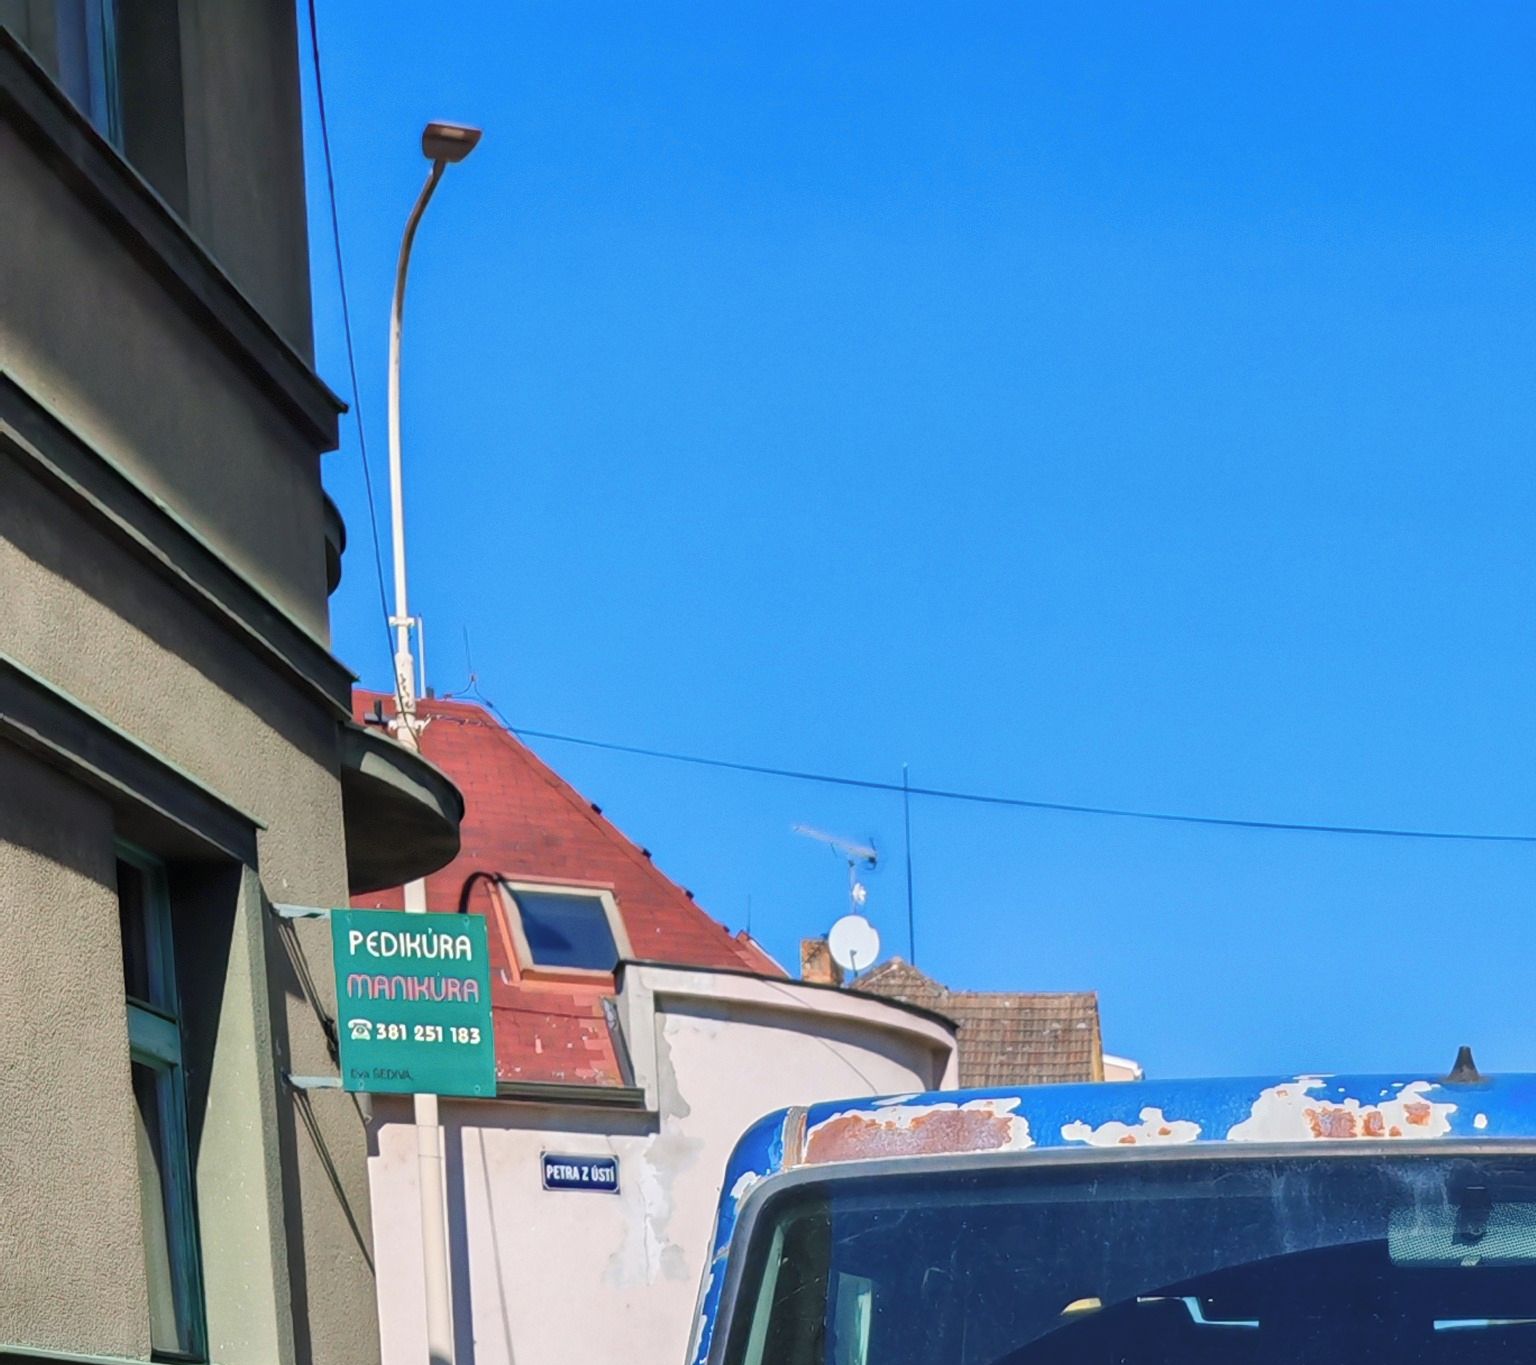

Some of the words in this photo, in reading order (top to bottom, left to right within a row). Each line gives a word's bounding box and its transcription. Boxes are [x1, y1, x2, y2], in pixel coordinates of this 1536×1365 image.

[348, 928, 472, 961] PEDIKÚRA
[346, 972, 479, 1003] MANIKÚRA
[376, 1023, 406, 1041] 381
[414, 1025, 443, 1042] 251
[450, 1027, 481, 1045] 183
[546, 1165, 580, 1181] PETRA
[581, 1166, 590, 1181] Z
[591, 1165, 615, 1182] ÚSTÍ
